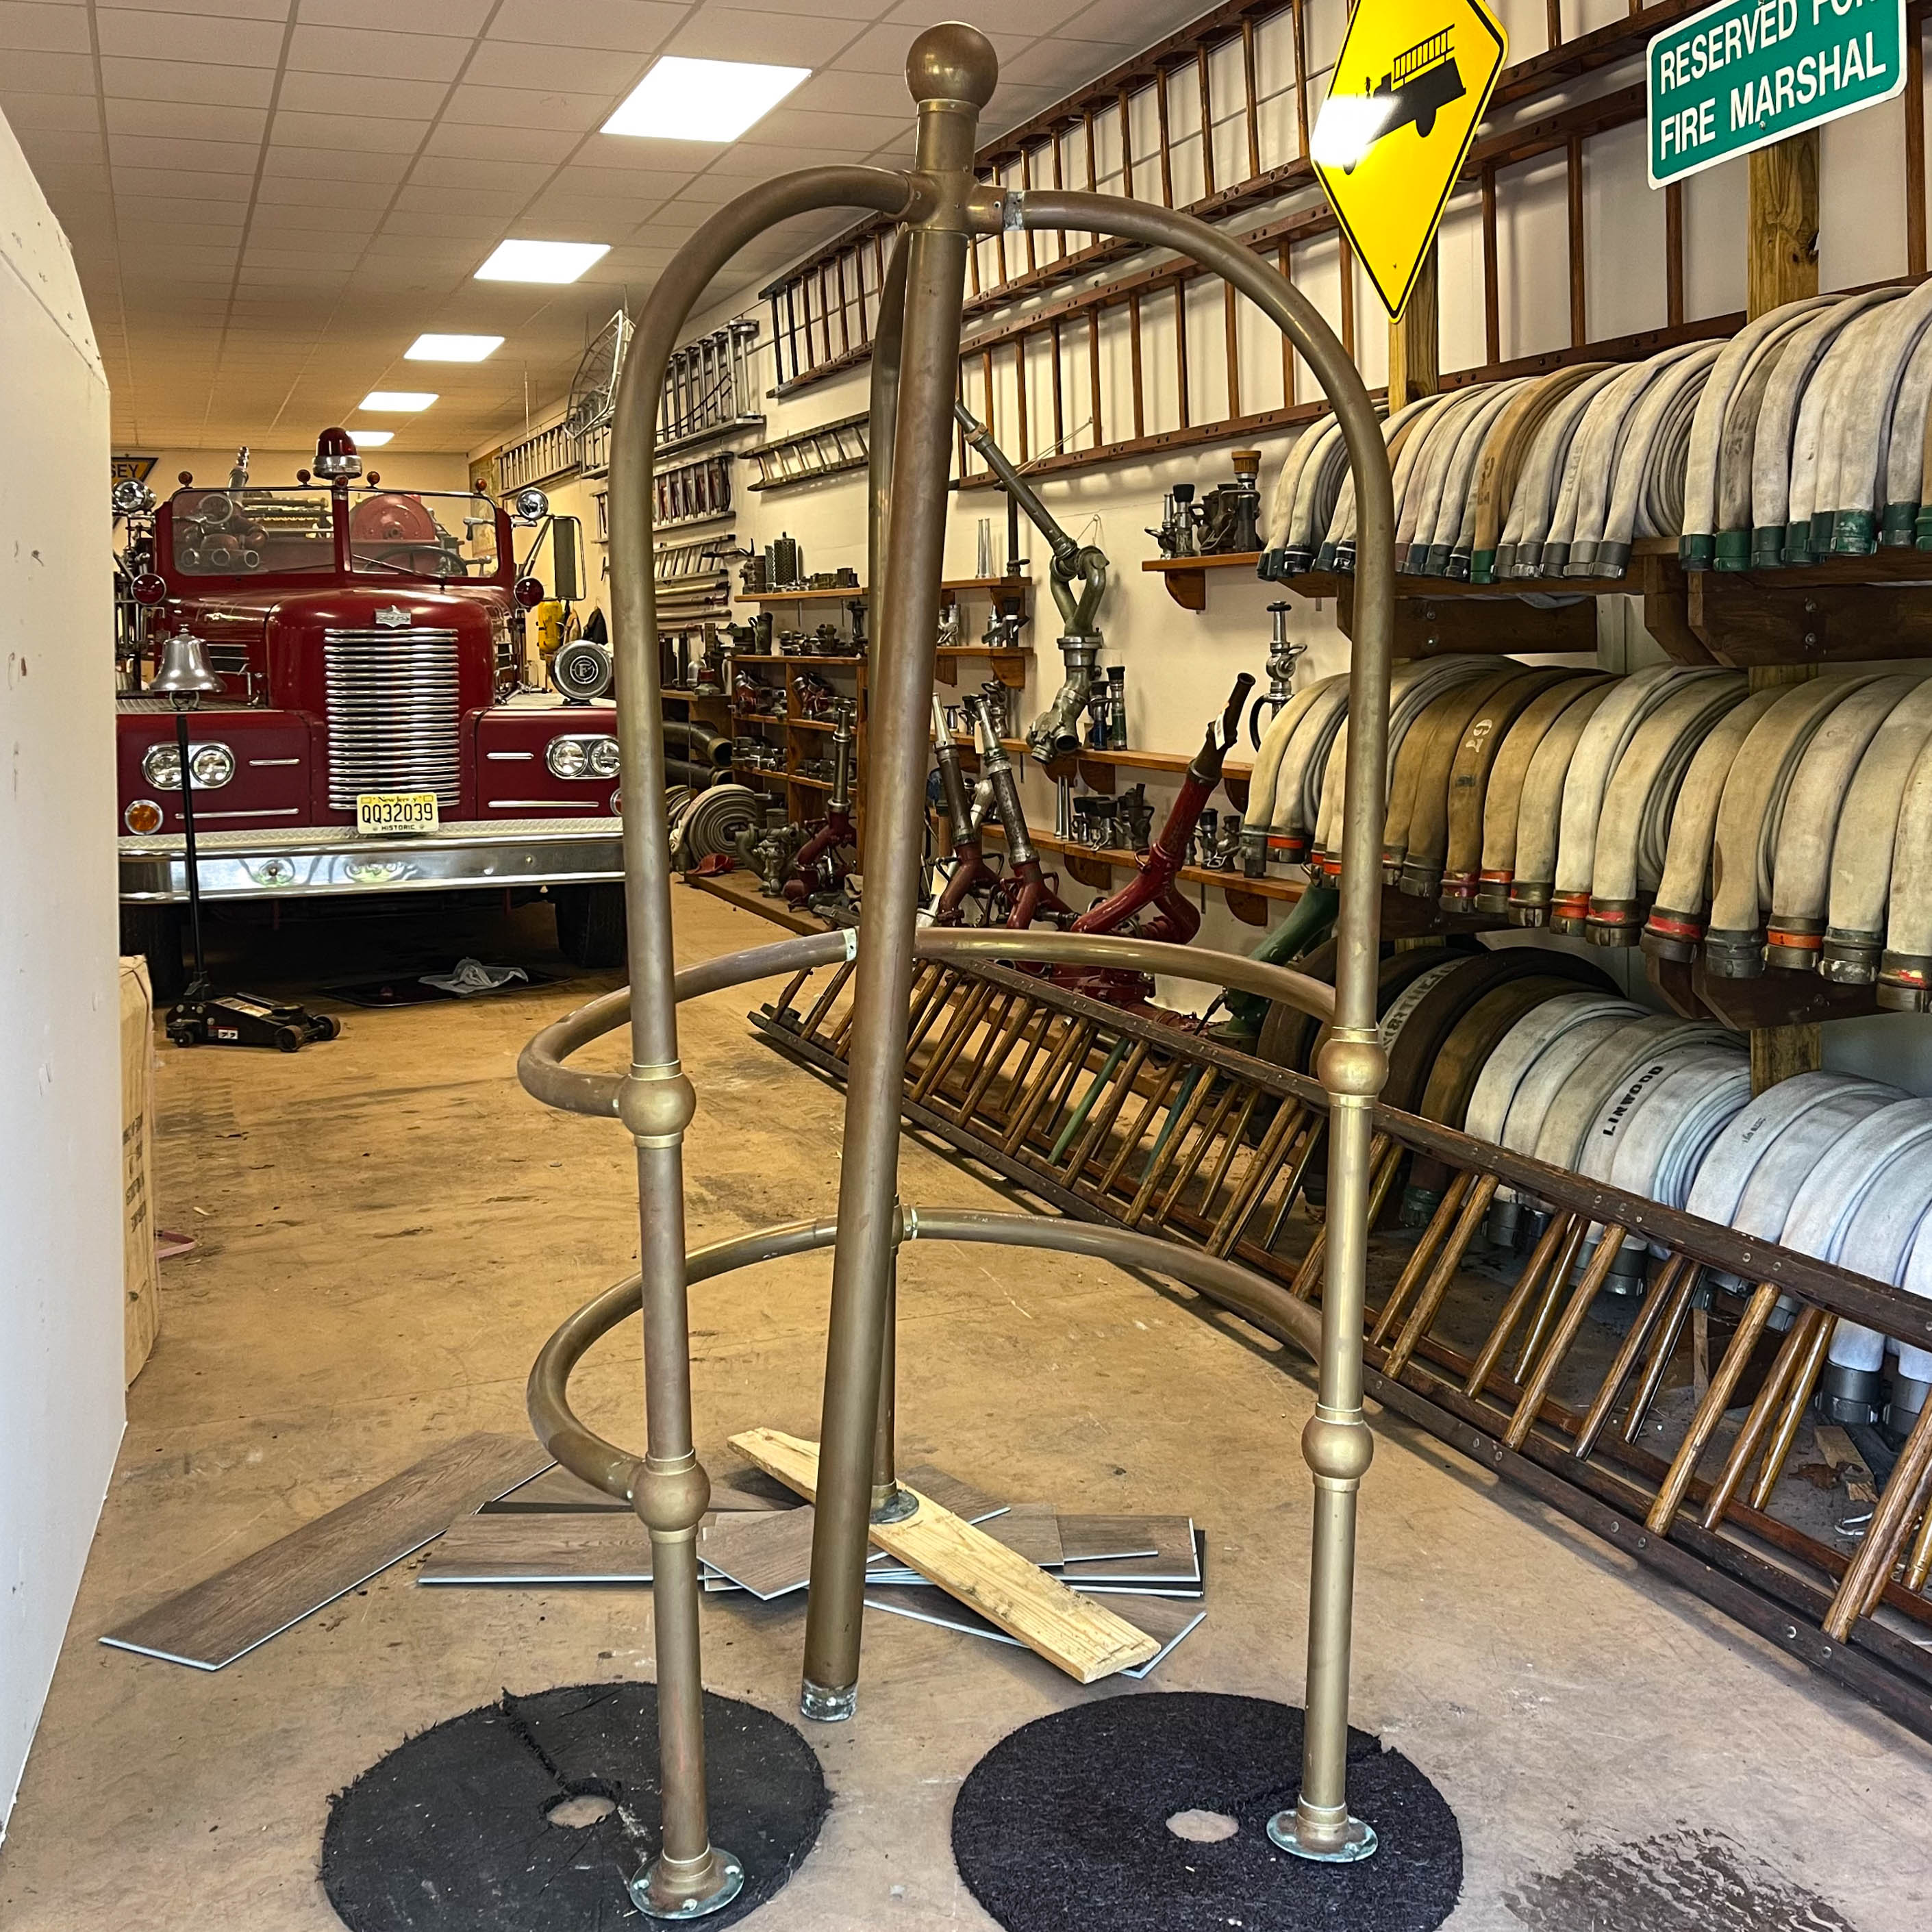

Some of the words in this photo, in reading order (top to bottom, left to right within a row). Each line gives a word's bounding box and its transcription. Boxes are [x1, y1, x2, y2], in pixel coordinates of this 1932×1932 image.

[1661, 0, 1798, 95] RESERVED
[1661, 97, 1716, 161] FIRE
[1731, 32, 1887, 131] MARSHAL
[362, 803, 433, 823] QQ32039
[1603, 1066, 1664, 1137] LINWOOD
